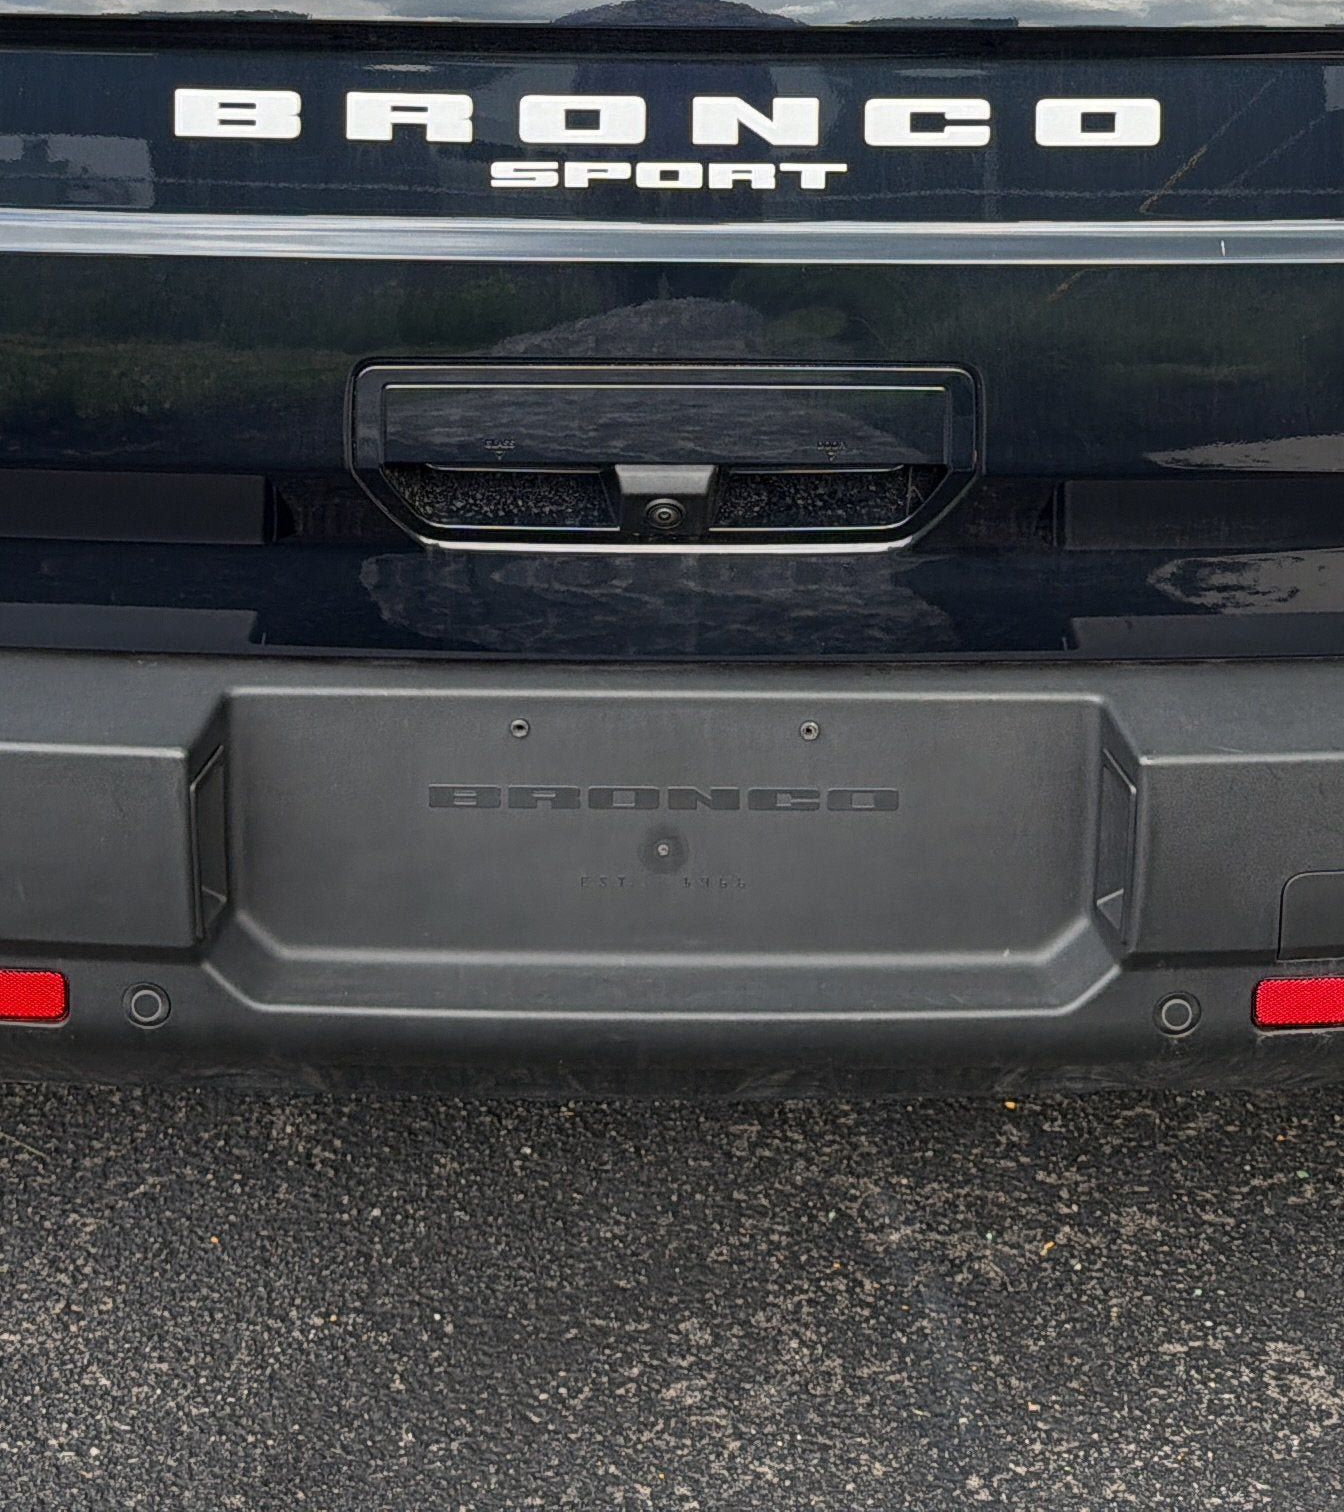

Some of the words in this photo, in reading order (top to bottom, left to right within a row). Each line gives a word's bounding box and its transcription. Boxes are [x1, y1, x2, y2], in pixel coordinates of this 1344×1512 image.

[173, 88, 1162, 148] BRONCO
[489, 161, 848, 190] SPORT
[428, 784, 900, 811] BRONCO
